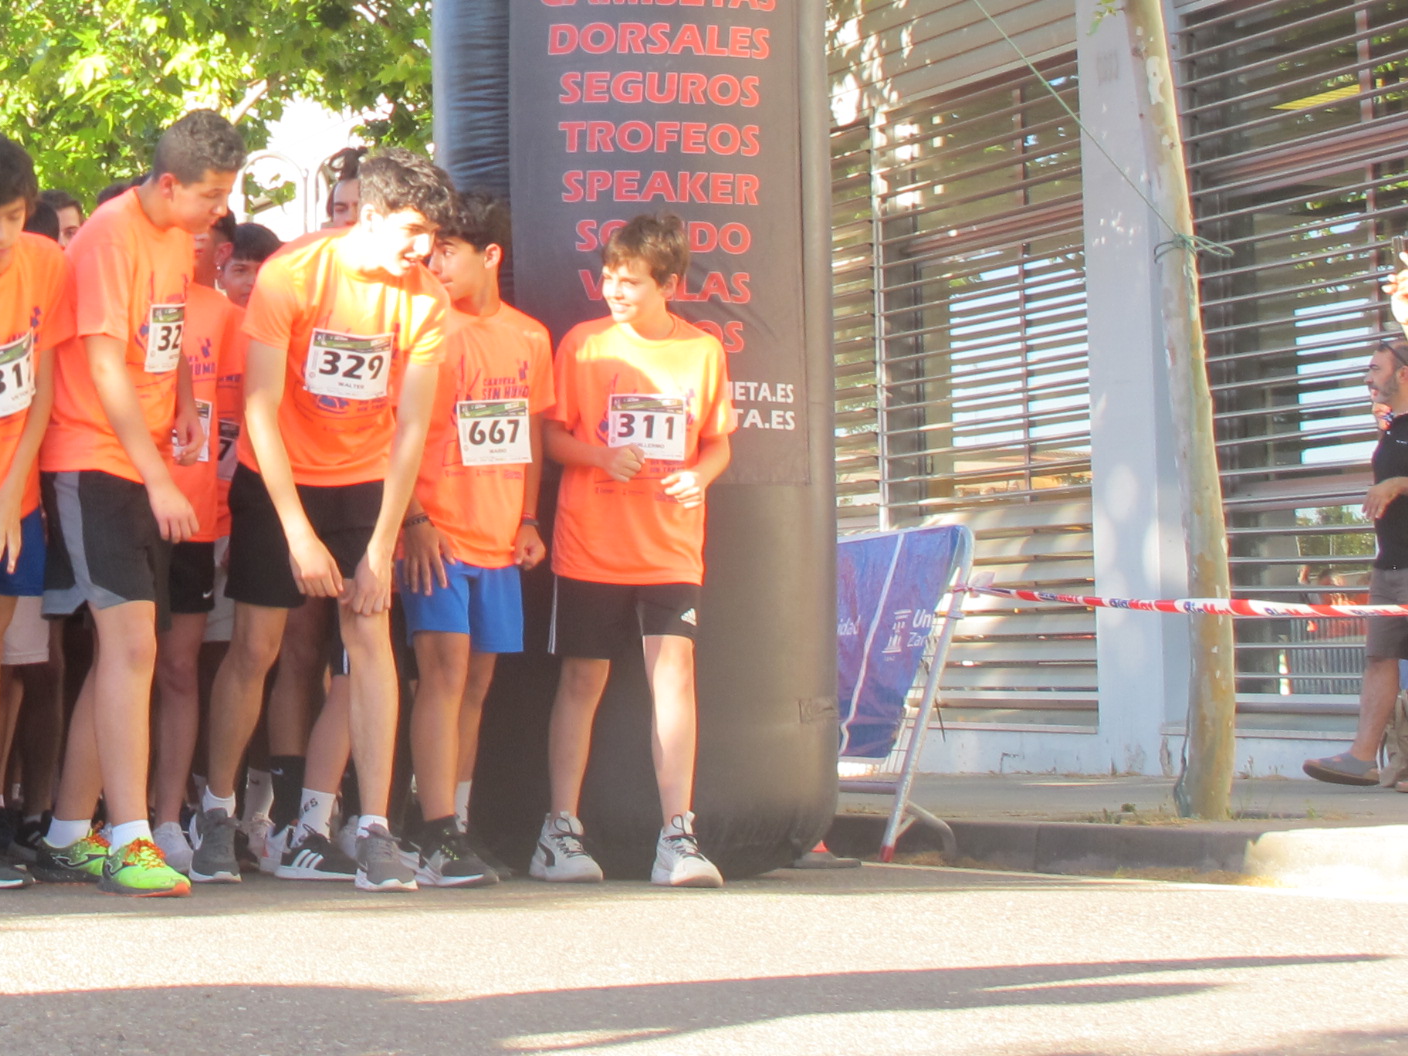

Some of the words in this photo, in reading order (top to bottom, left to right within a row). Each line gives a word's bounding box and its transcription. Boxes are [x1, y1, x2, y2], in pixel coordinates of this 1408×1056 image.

[548, 23, 770, 60] DORSALES
[559, 71, 761, 107] SEGUROS
[558, 120, 761, 157] TROFEOS
[561, 170, 760, 206] SPEAKER
[575, 219, 752, 255] SODO
[578, 269, 751, 304] VLAS
[157, 325, 183, 352] 32
[318, 350, 384, 381] 329
[468, 419, 520, 446] 667
[617, 413, 675, 441] 311
